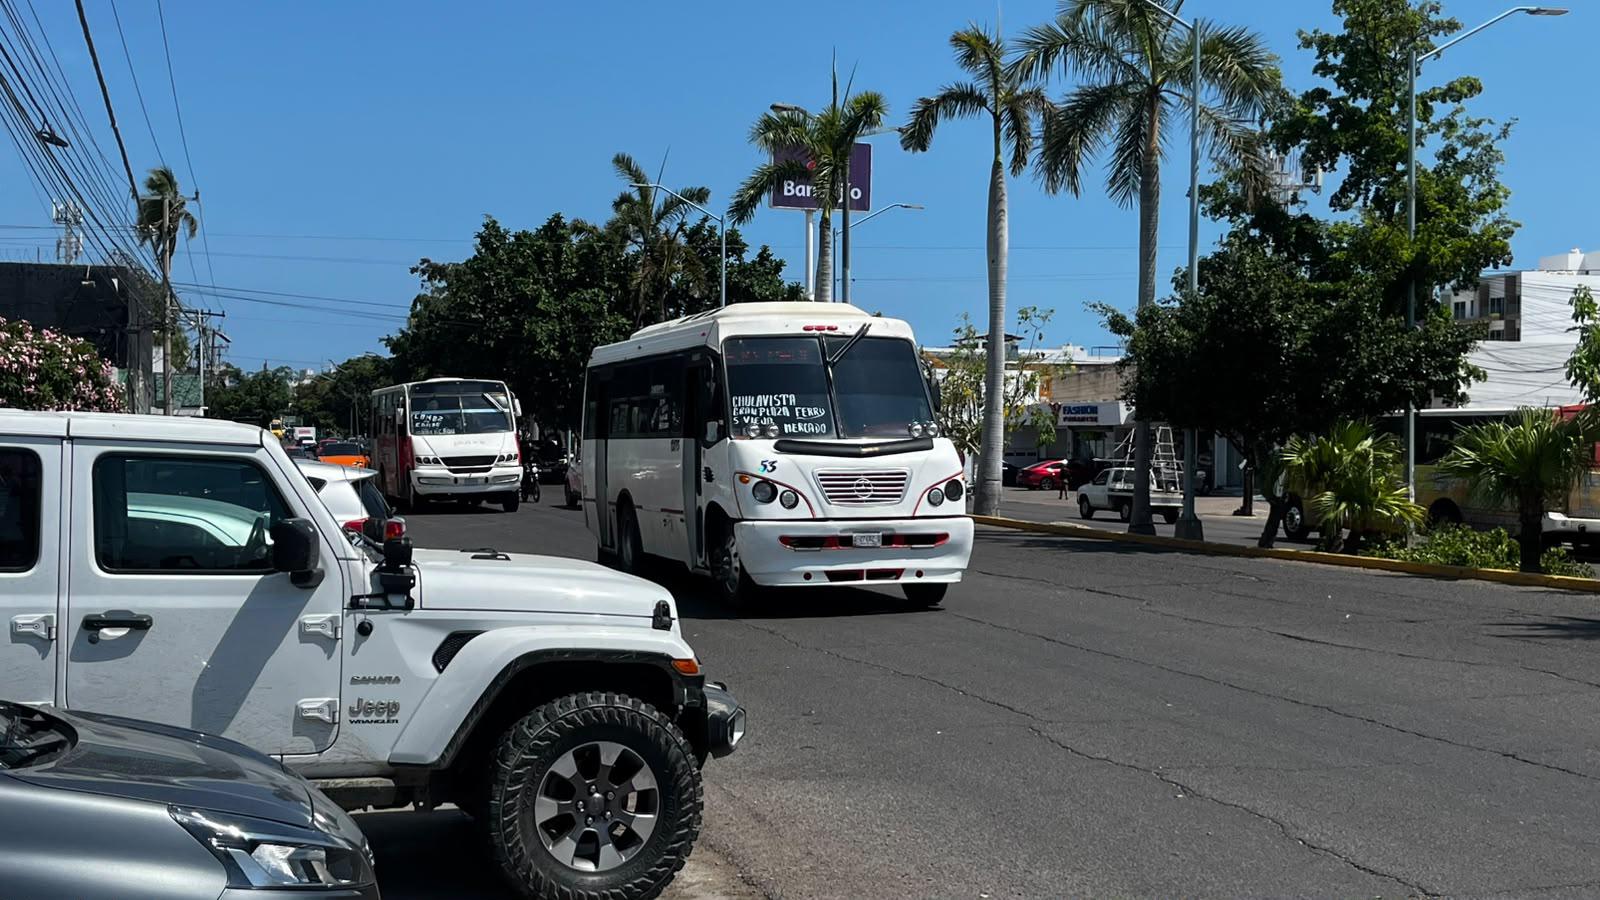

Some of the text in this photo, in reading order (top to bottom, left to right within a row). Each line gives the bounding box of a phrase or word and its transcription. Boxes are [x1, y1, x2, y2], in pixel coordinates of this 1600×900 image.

[732, 394, 796, 407] CHULAVISTA
[784, 423, 826, 433] MERCADO
[759, 460, 777, 473] 53
[350, 676, 401, 685] SAHARA
[349, 698, 400, 719] Jeep
